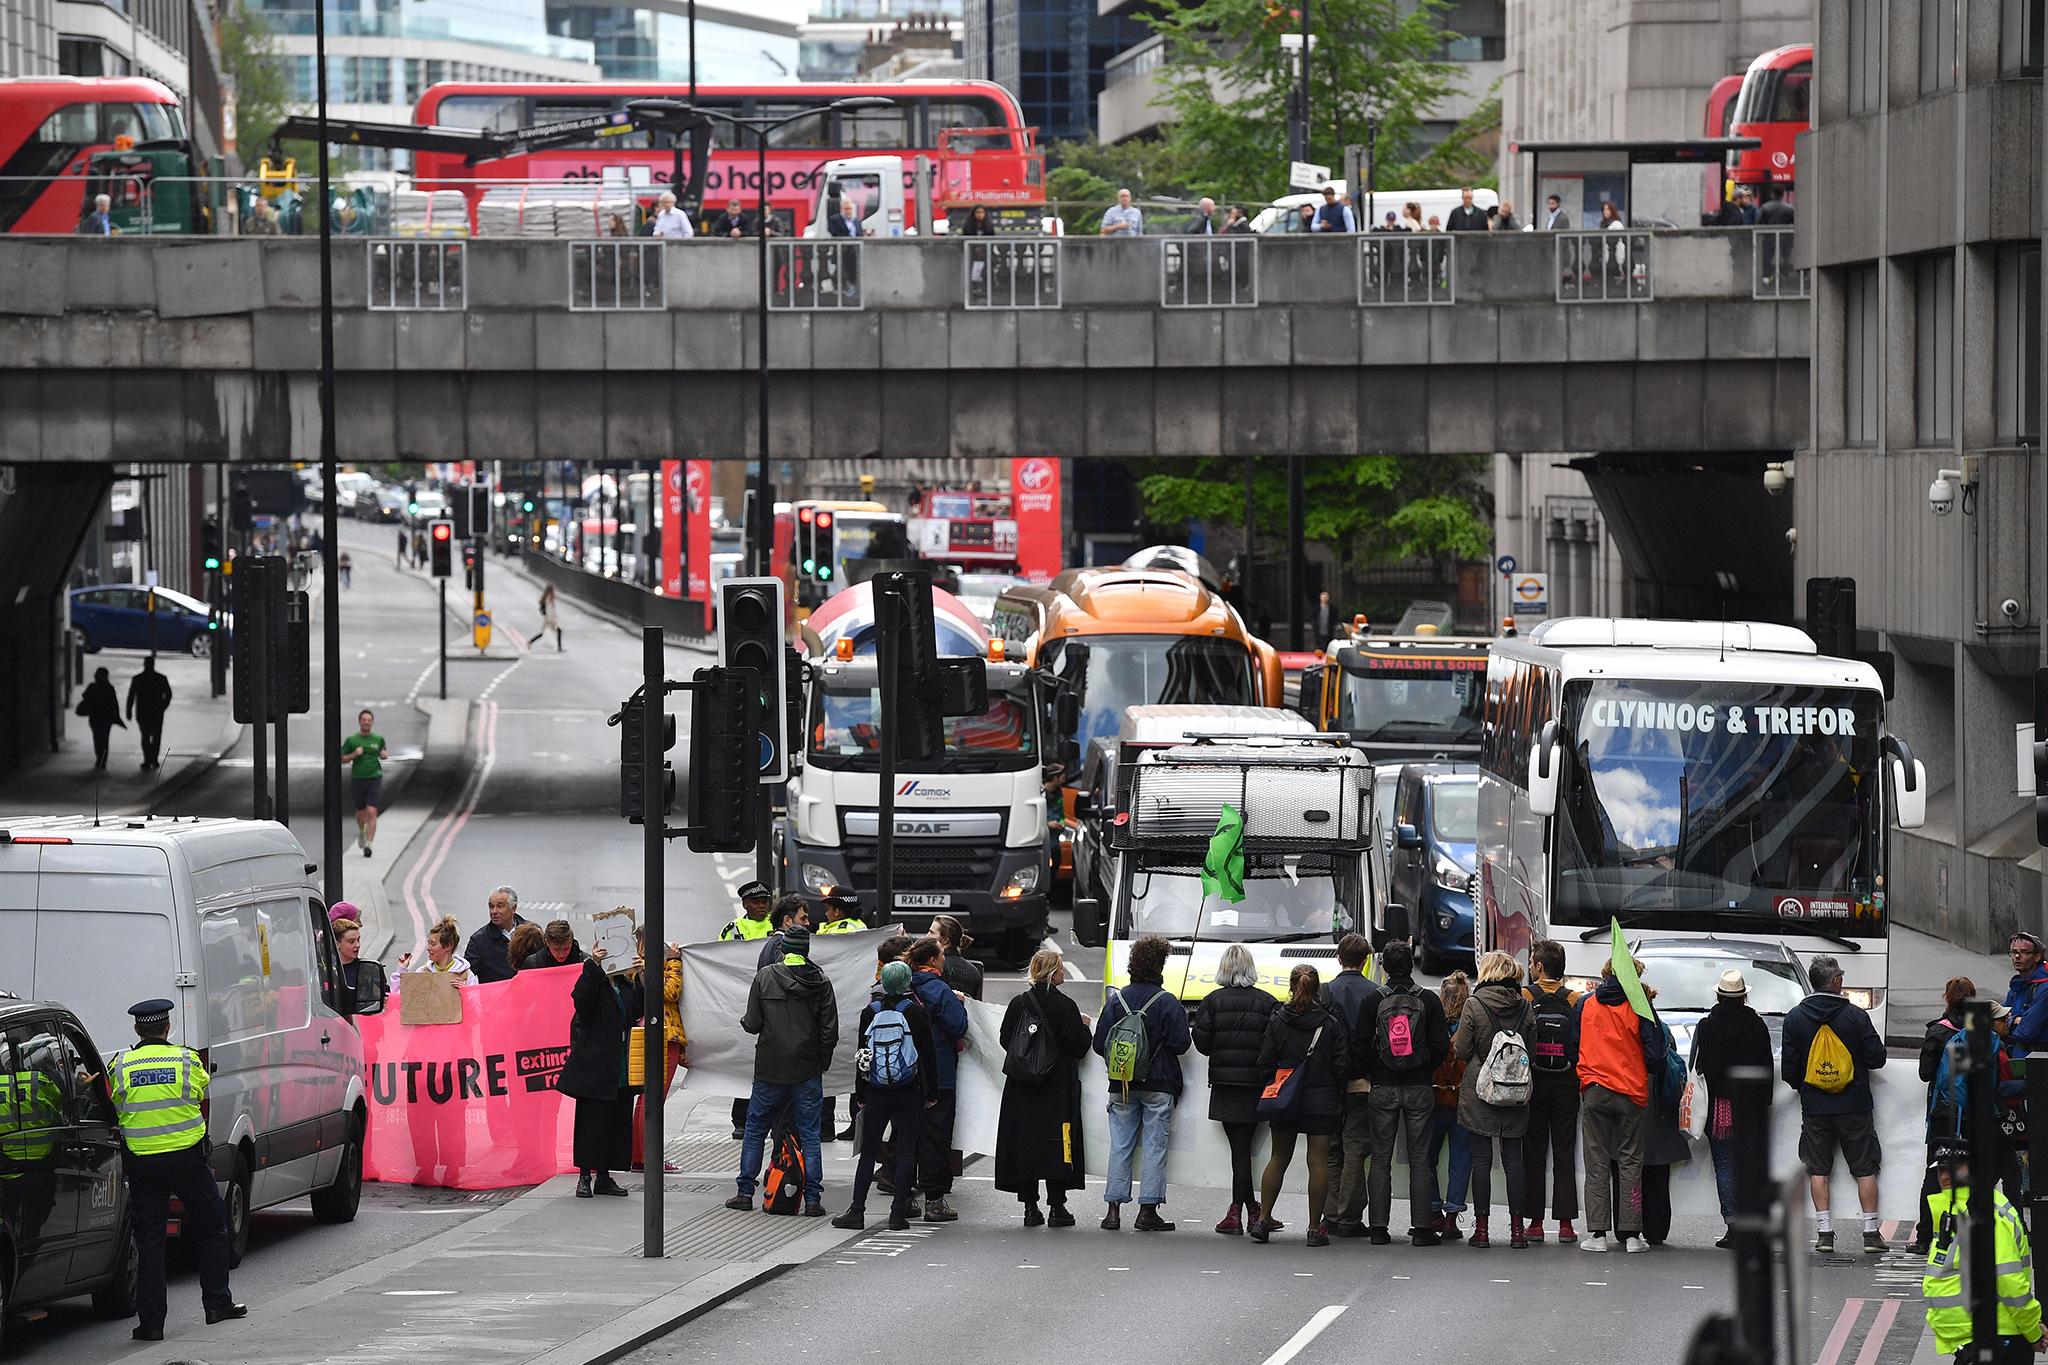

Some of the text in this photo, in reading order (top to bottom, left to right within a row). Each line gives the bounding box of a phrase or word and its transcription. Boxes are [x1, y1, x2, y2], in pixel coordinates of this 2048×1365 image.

[728, 165, 785, 195] hop
[1435, 659, 1444, 669] &
[1447, 660, 1486, 670] SONS
[1592, 700, 1856, 736] CLYNNOG & TREFOR
[896, 823, 950, 833] DAF
[901, 896, 945, 905] RX14 TFZ
[1810, 901, 1849, 910] INTERNATIONAL
[1810, 909, 1849, 918] SPORTS TOURS
[1186, 973, 1290, 987] POCE
[131, 1068, 175, 1077] METROPOLITAN
[131, 1073, 175, 1087] POLICE
[364, 1054, 508, 1105] UTURE
